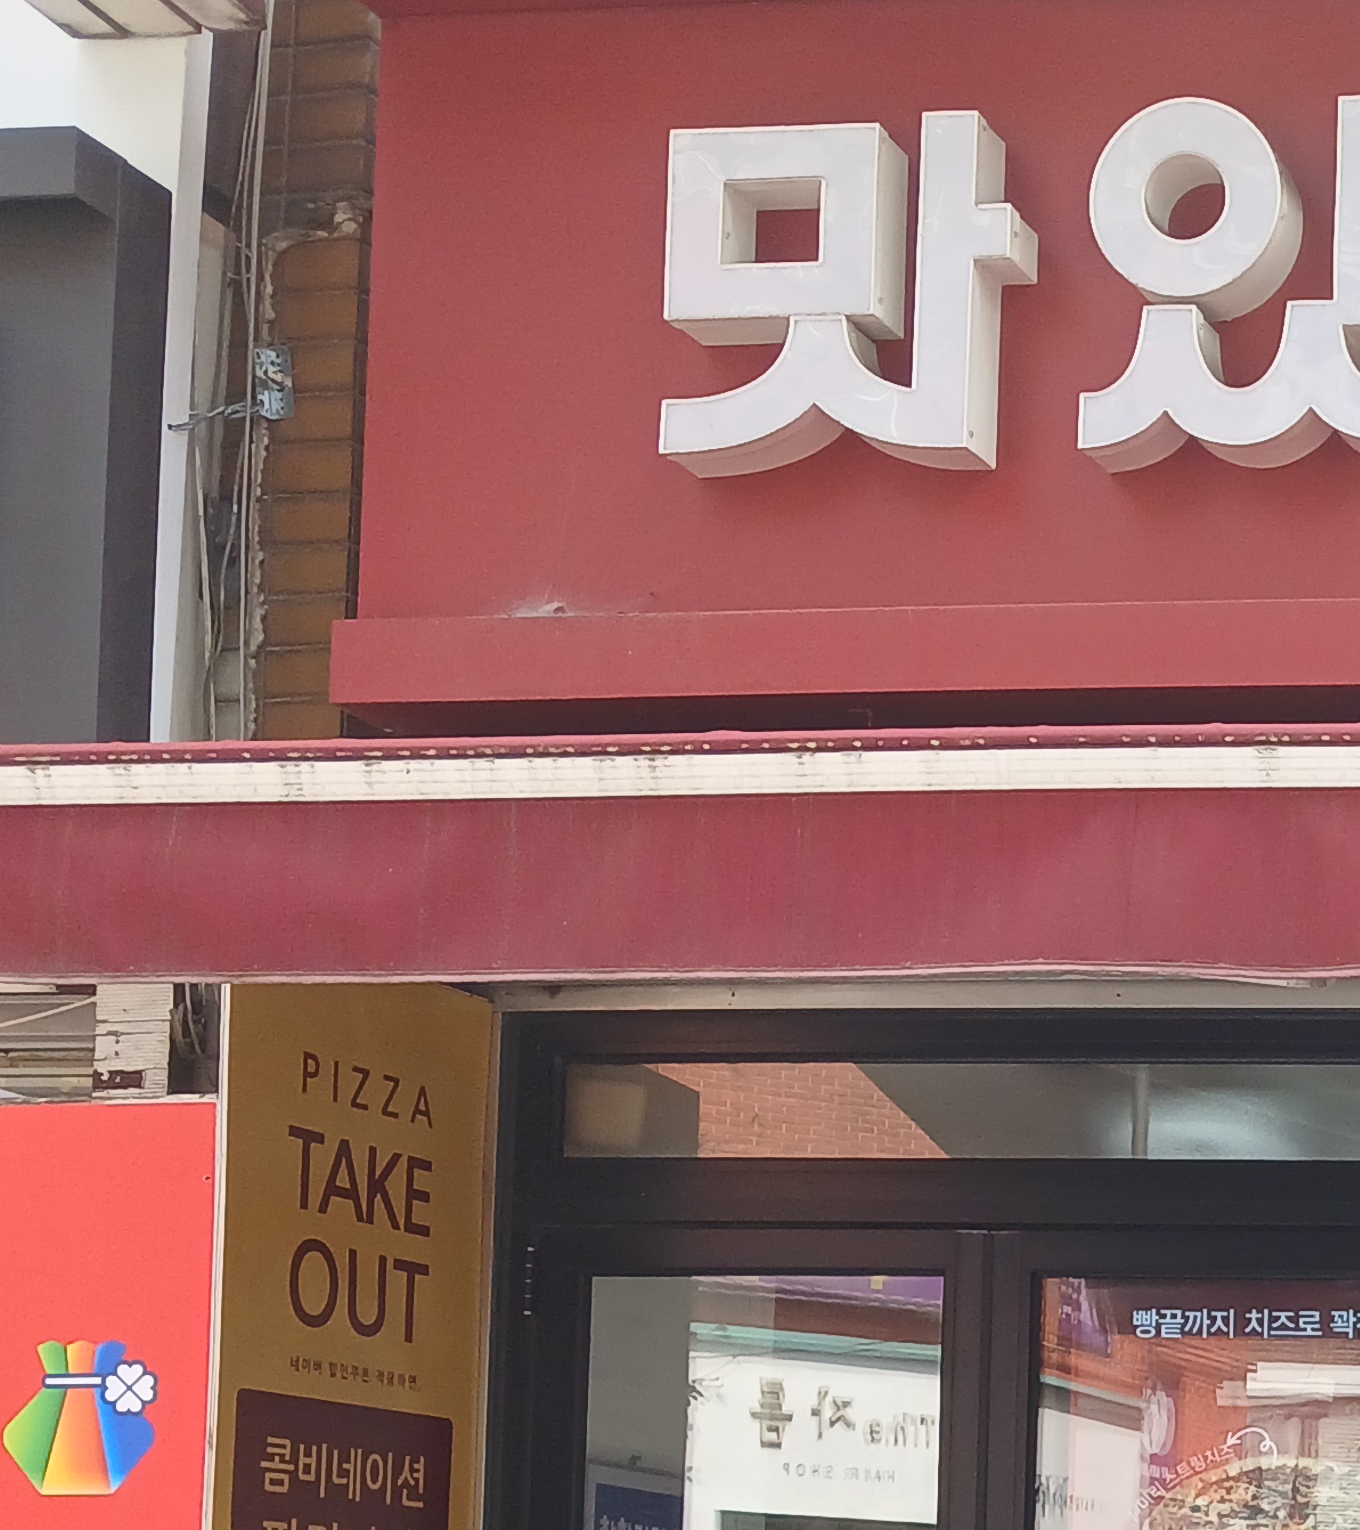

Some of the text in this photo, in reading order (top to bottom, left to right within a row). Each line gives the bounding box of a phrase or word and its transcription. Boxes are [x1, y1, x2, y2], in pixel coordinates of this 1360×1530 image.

[302, 1050, 433, 1130] PIZZA
[288, 1124, 433, 1239] TAKE
[289, 1237, 430, 1345] OUT
[1132, 1308, 1235, 1340] 빵끝까지
[1244, 1310, 1323, 1340] 치즈로
[259, 1436, 426, 1509] 콤비네이션
